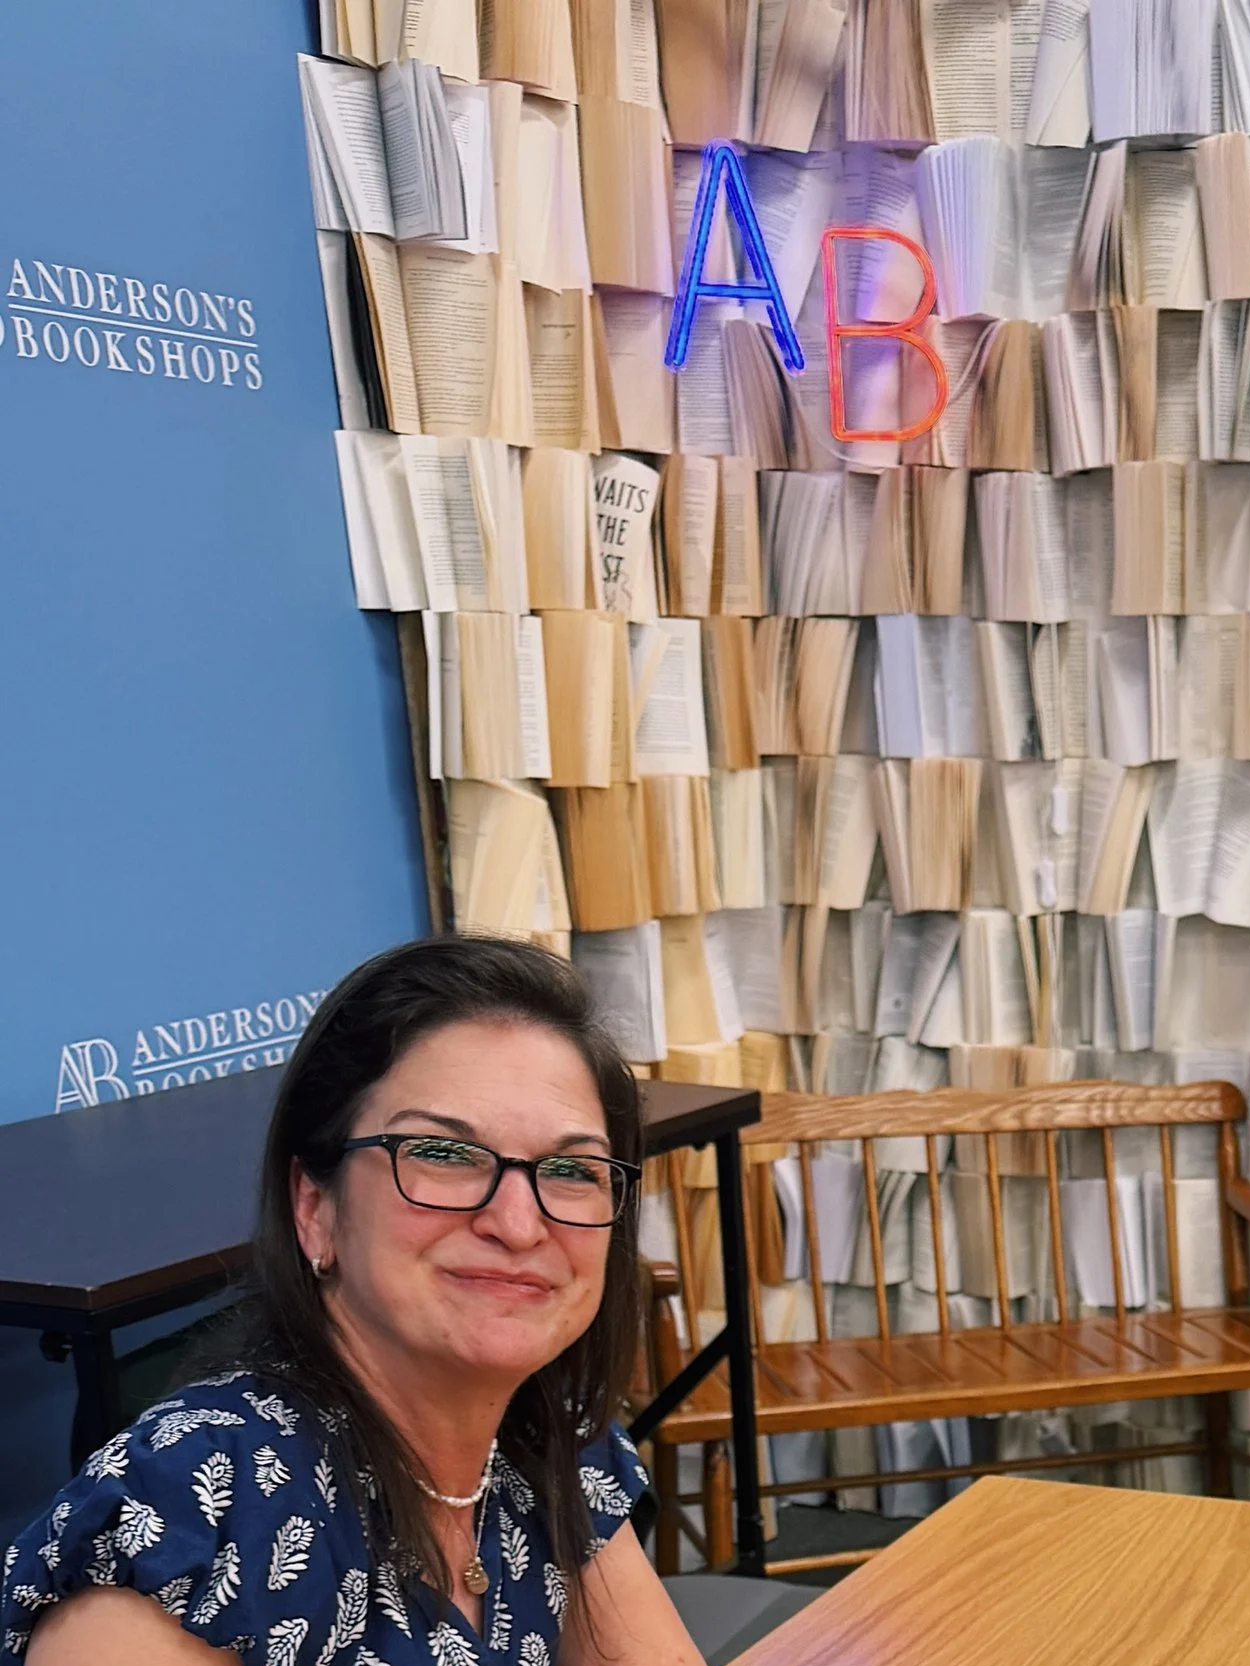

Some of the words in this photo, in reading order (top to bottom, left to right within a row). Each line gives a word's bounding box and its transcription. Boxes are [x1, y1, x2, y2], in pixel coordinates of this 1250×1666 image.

[6, 258, 258, 337] ANDERSON'S
[11, 315, 264, 391] BOOKSHOPS
[597, 512, 630, 546] THE
[600, 550, 624, 583] ST
[131, 988, 330, 1067] ANDERSON'
